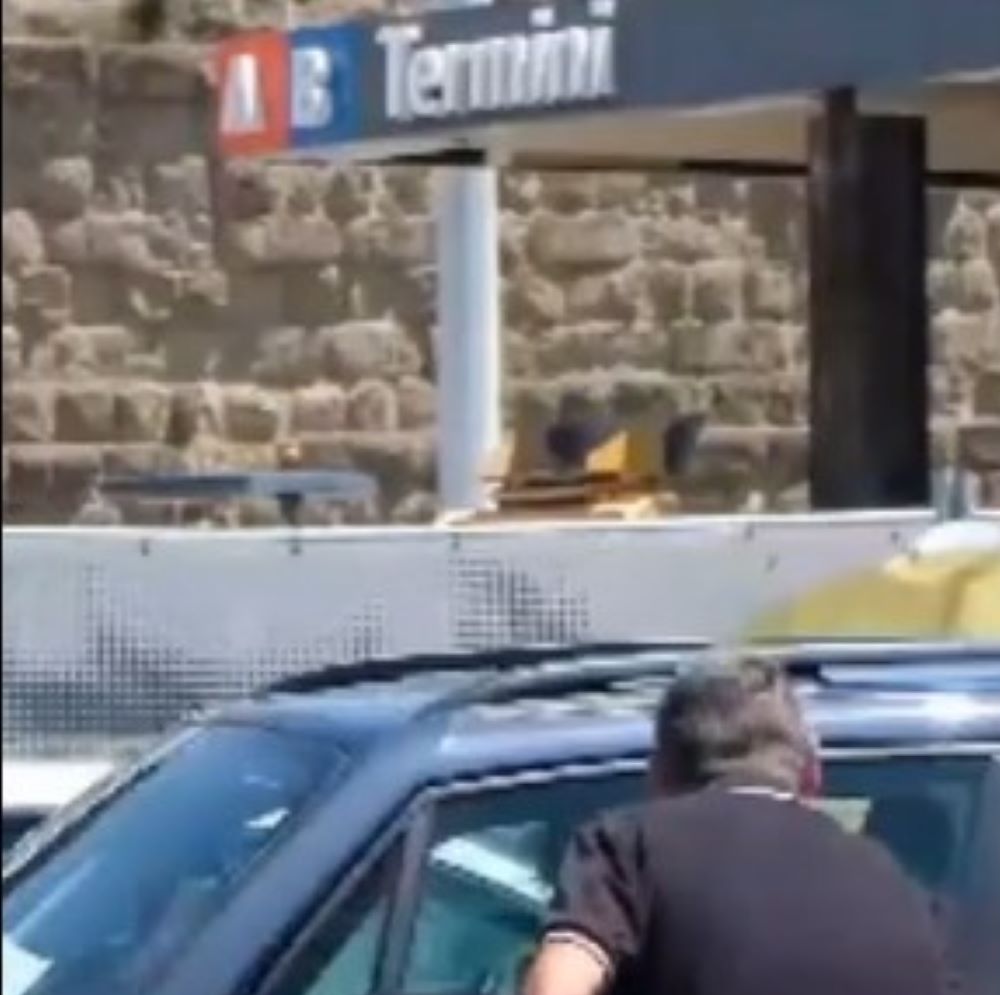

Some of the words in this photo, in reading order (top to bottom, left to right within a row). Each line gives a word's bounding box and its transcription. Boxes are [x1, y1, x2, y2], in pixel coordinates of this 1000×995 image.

[218, 53, 265, 135] A
[289, 47, 334, 129] B
[374, 0, 616, 120] Termini
